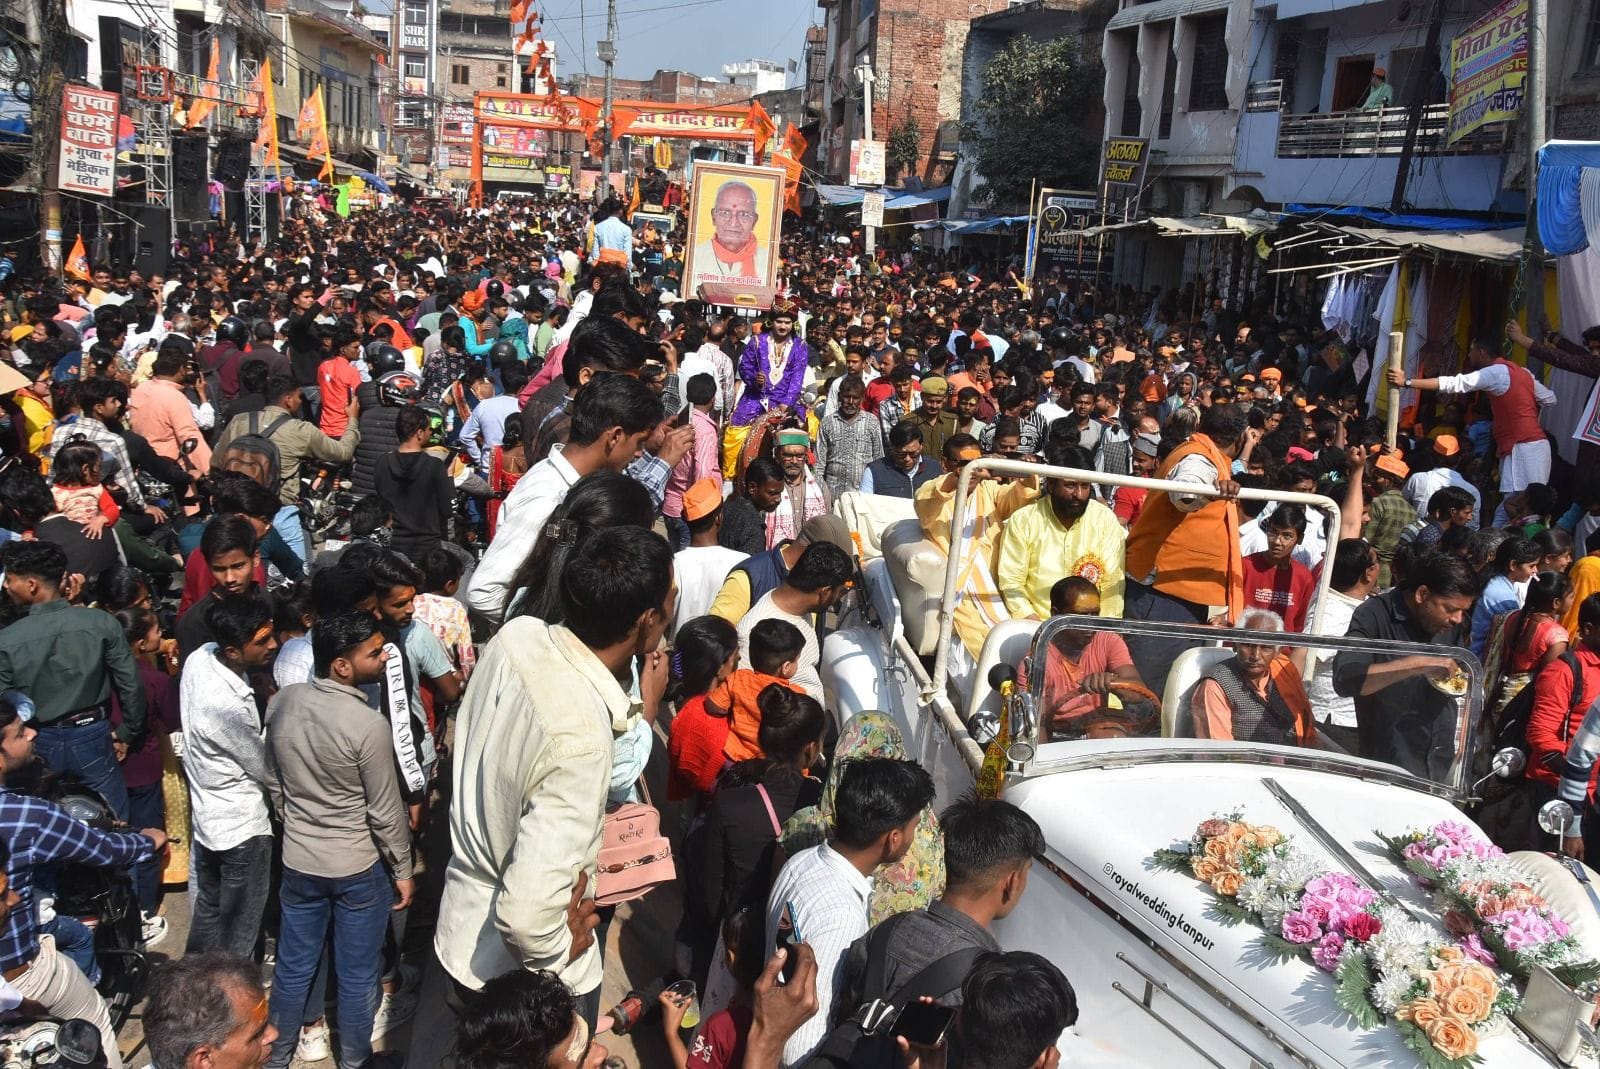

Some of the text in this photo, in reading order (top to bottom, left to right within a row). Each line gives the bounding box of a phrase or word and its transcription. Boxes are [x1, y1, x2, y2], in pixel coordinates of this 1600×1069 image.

[68, 92, 115, 112] गुप्ता
[66, 127, 114, 146] वाले
[76, 147, 103, 160] गुप्ता
[1106, 140, 1144, 161] अलका
[66, 159, 110, 176] मेडिकल
[76, 173, 100, 187] स्टोर
[397, 721, 421, 776] AMIRI
[1111, 871, 1215, 950] royalweddingkanpur
